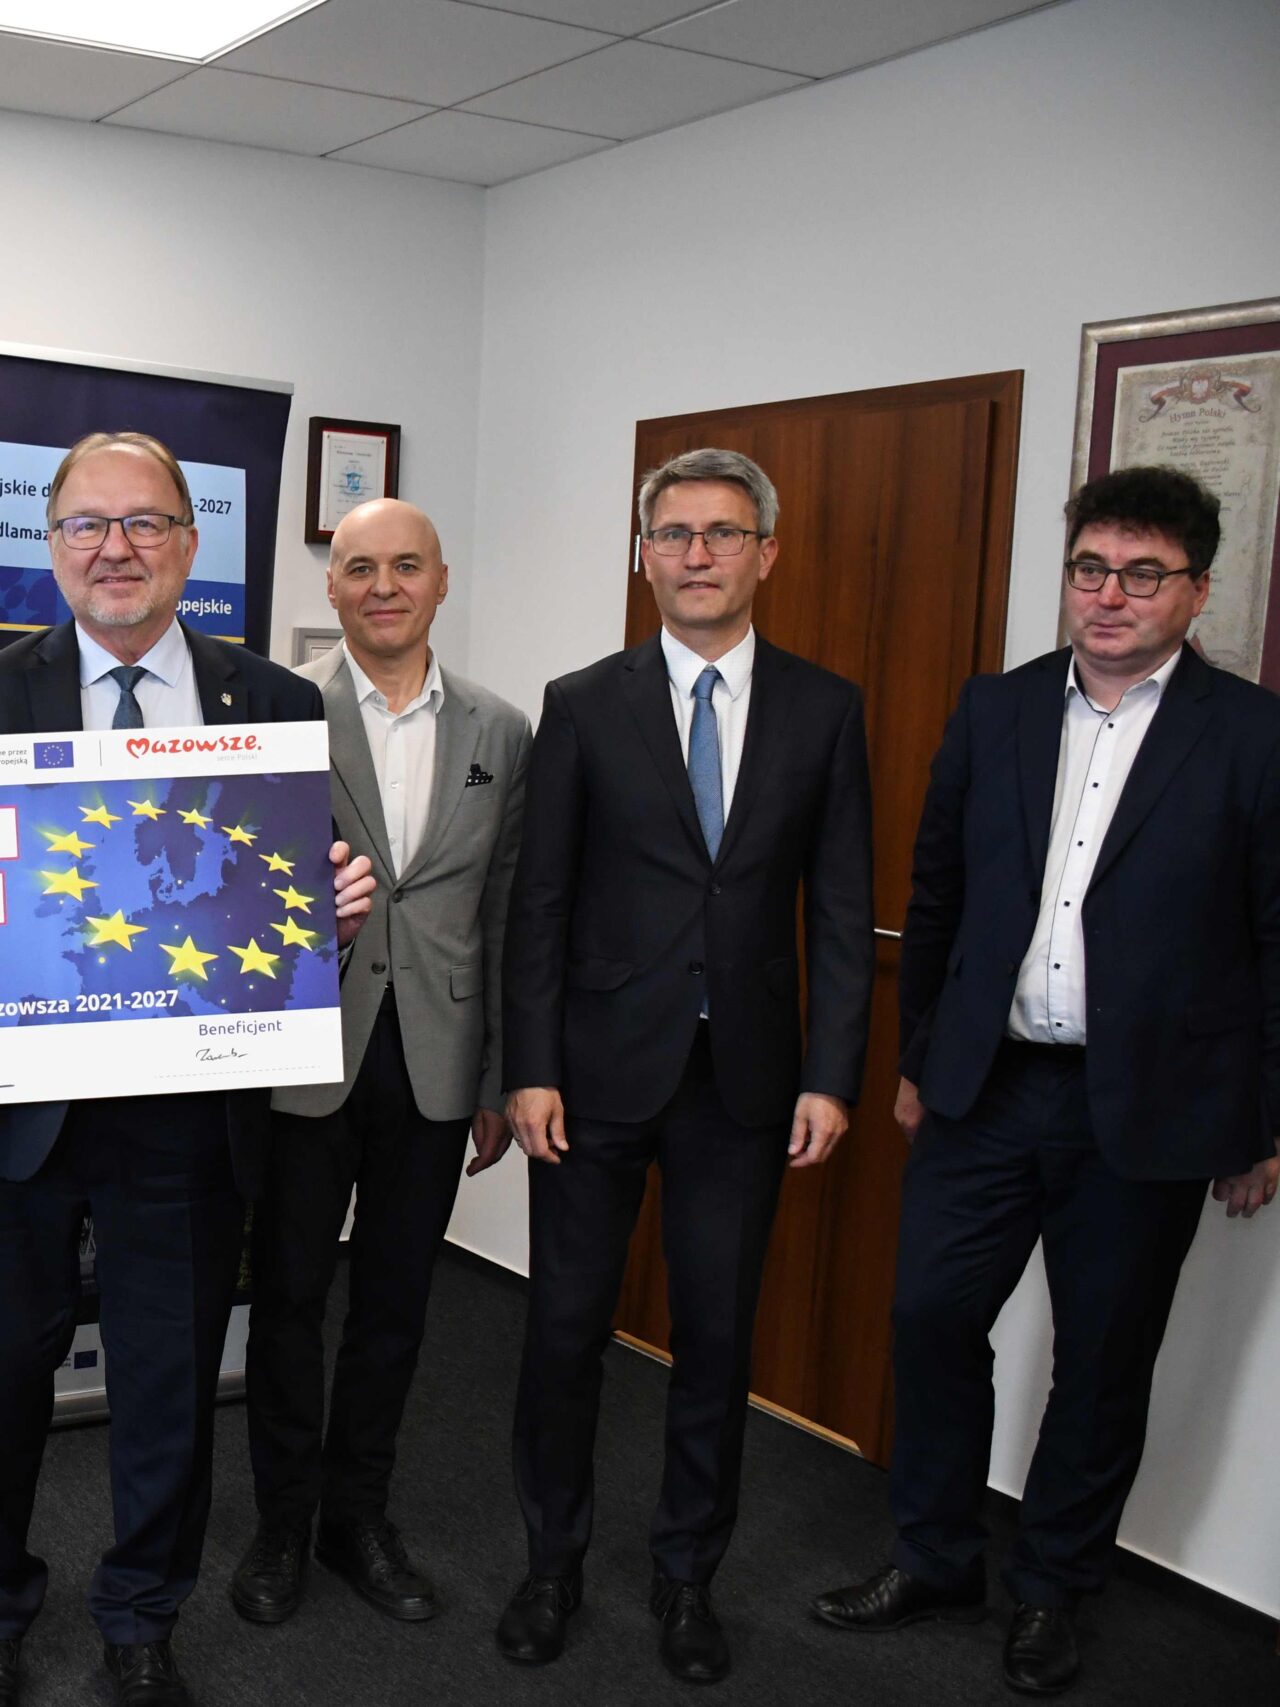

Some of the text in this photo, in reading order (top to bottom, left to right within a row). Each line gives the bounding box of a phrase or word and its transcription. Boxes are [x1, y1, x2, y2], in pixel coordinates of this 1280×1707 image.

[194, 498, 232, 515] -2027
[8, 749, 28, 758] przez
[76, 989, 179, 1013] 2021-2027
[198, 1019, 283, 1037] Beneficjent
